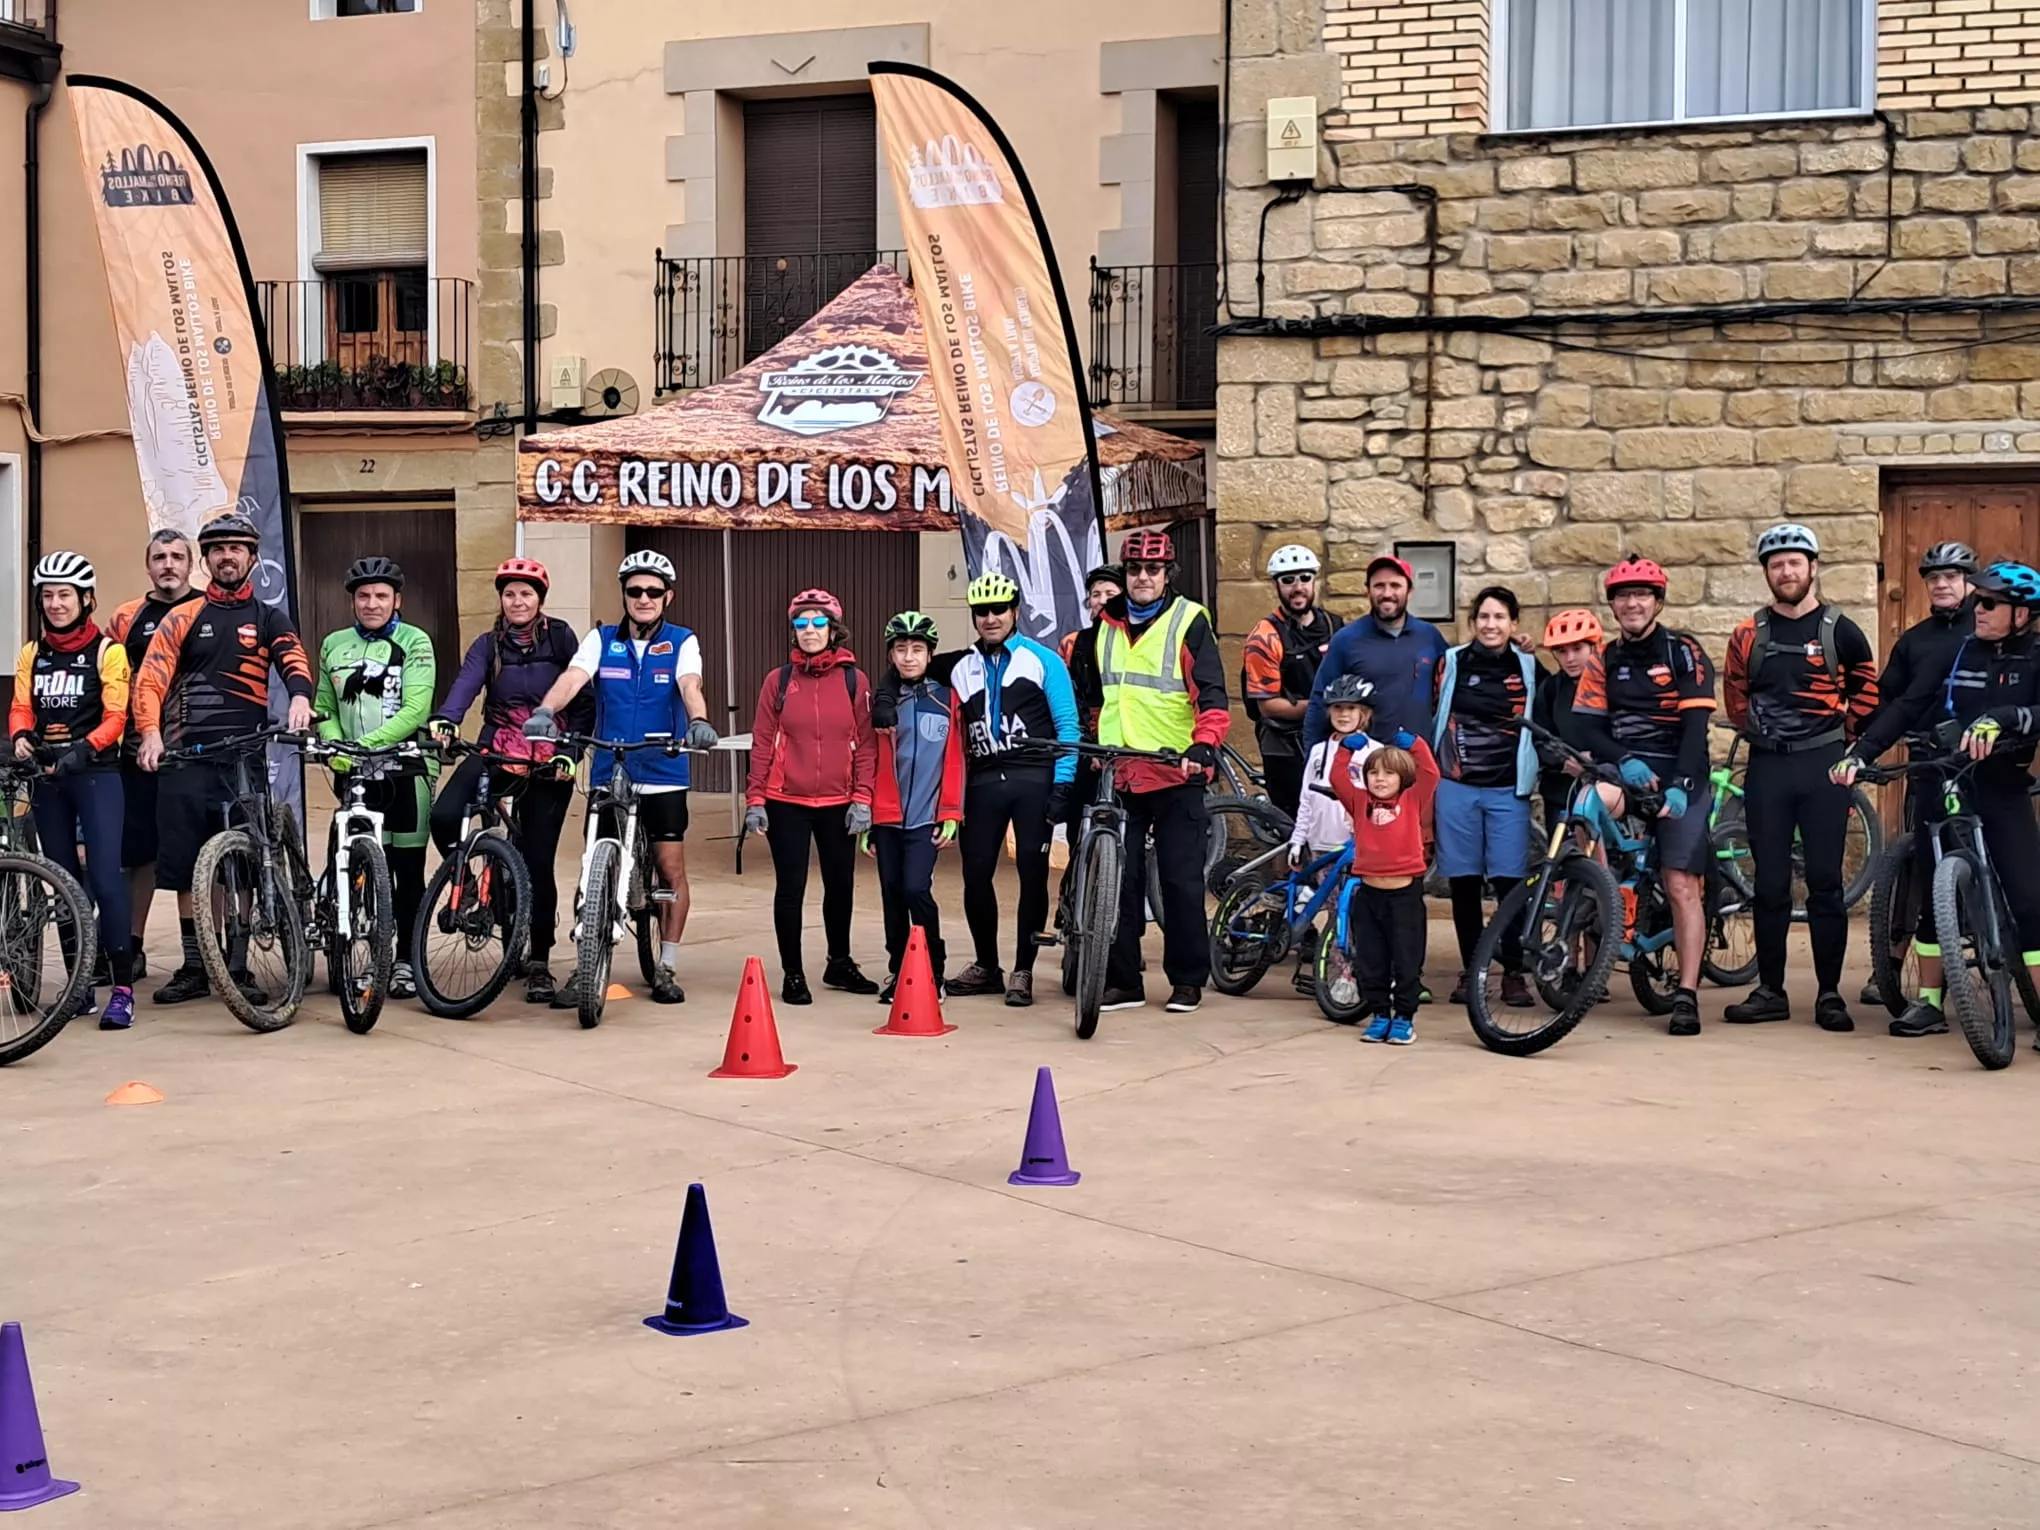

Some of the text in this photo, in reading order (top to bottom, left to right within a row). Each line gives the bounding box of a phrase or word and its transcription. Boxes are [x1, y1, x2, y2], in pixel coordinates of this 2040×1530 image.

[768, 374, 915, 388] Reino de los Mallos
[360, 459, 375, 473] 22
[535, 459, 603, 504] C.C.
[619, 460, 741, 509] REINO
[757, 461, 813, 510] DE
[828, 462, 897, 512] LOS
[34, 671, 85, 696] PEDAL
[40, 696, 78, 708] STORE
